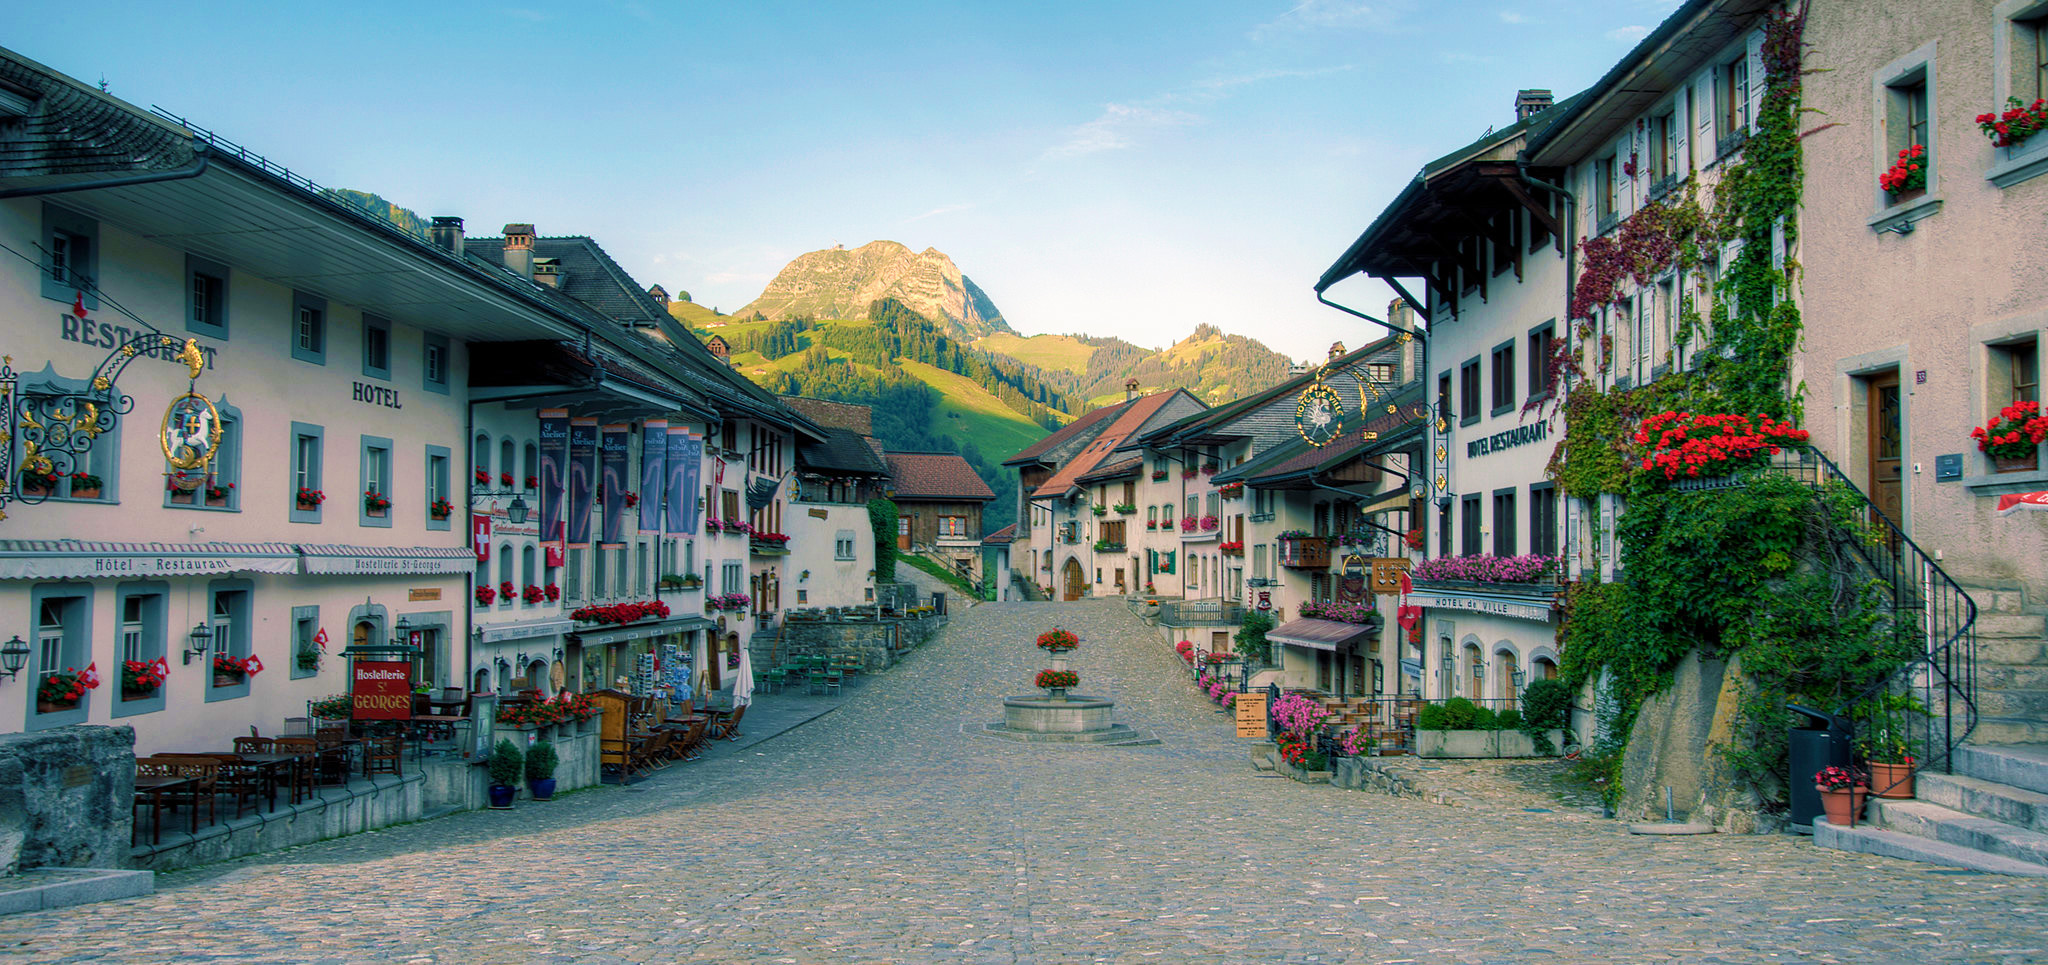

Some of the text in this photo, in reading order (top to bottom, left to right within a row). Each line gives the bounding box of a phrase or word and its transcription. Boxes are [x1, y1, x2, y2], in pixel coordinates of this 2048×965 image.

[61, 313, 217, 370] RESTAURT
[352, 381, 402, 409] HOTEL
[1296, 391, 1344, 417] HOTEL DE VILLE
[1467, 419, 1547, 459] HOTEL RESTAURANT
[95, 558, 132, 571] Hôtel
[156, 558, 231, 570] Restaurant
[355, 559, 441, 570] Hostellerie St-Georges
[1467, 599, 1477, 608] de
[1483, 601, 1508, 613] VILLE
[357, 668, 406, 680] Hostellerie
[354, 694, 410, 712] GEORGES
